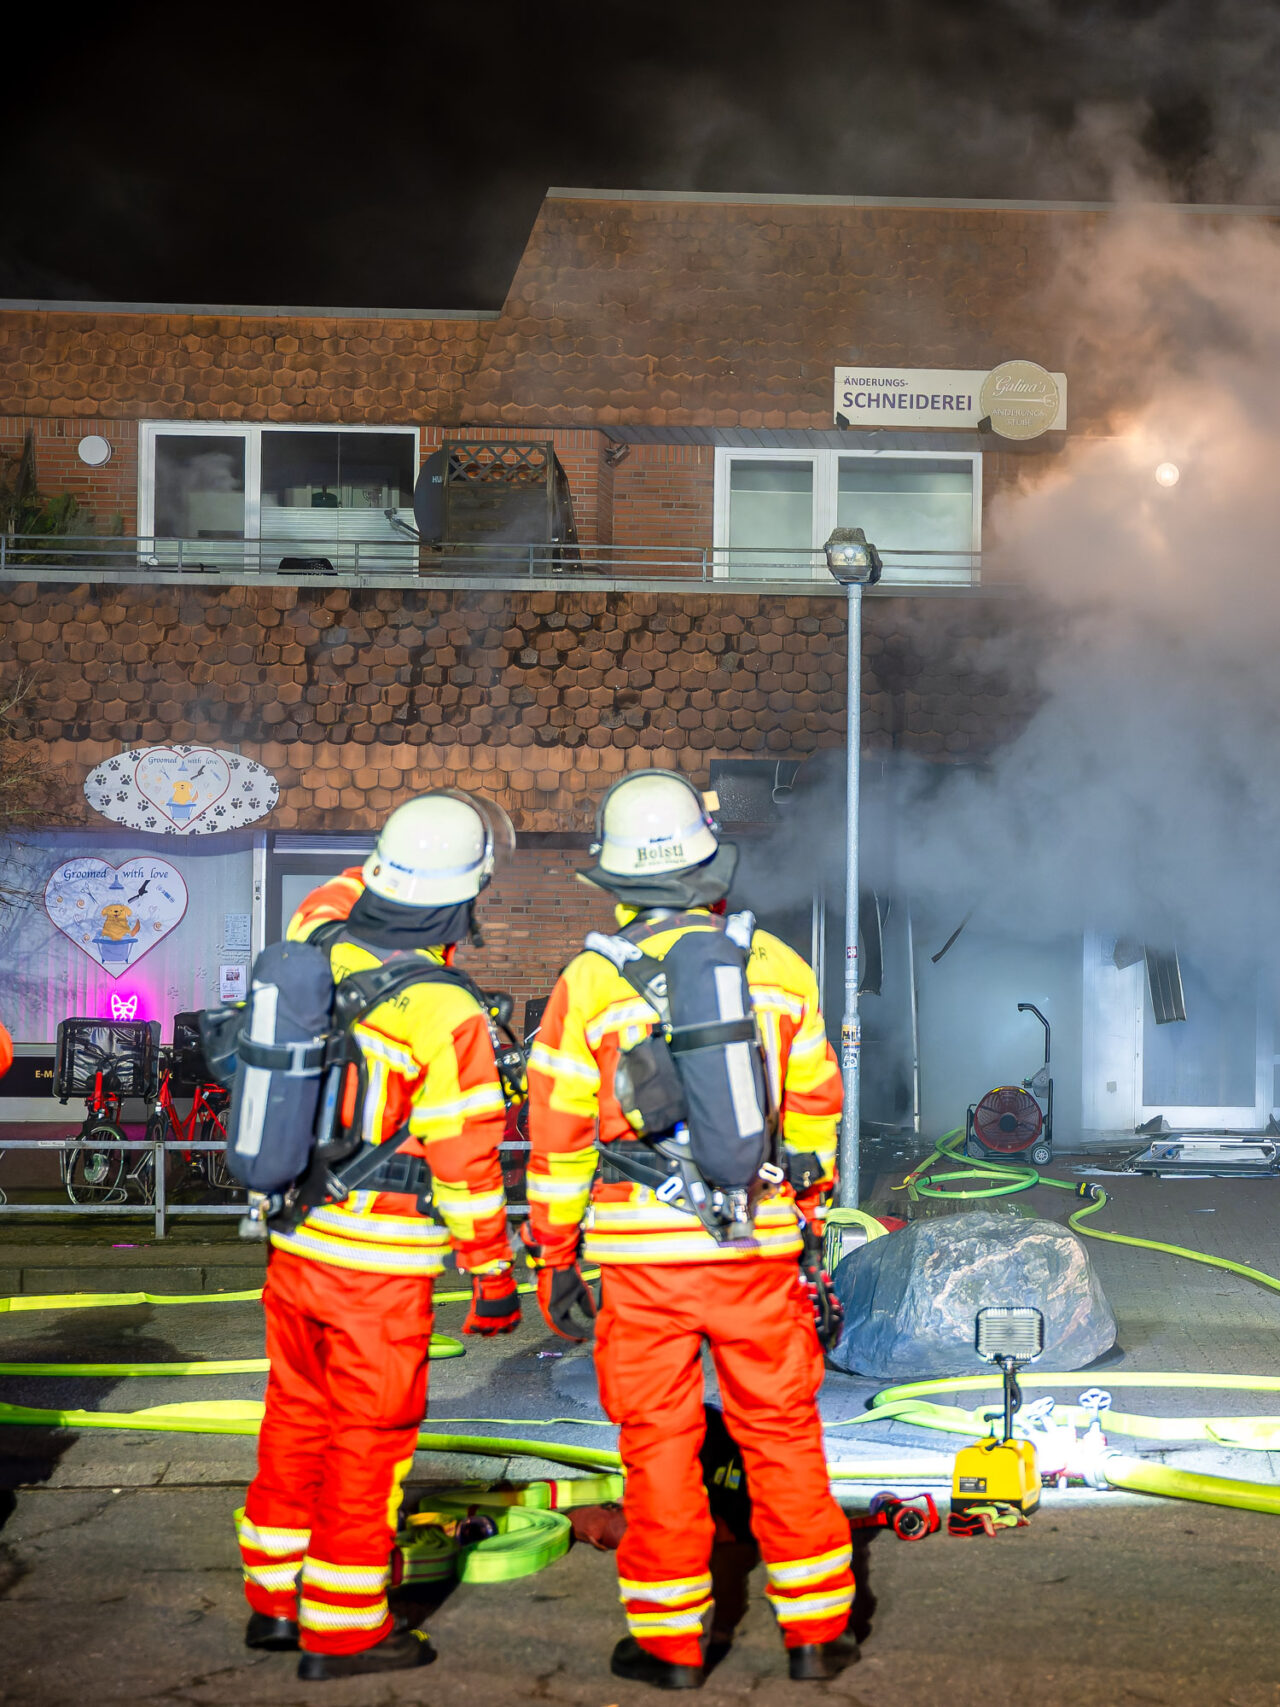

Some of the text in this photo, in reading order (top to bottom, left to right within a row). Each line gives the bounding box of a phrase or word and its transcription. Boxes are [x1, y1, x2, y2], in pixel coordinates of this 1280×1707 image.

[844, 376, 909, 387] ÄNDERUNGS-
[992, 375, 1046, 397] Galina's
[843, 391, 972, 411] SCHNEIDEREI
[148, 755, 219, 765] Groomed with love
[63, 866, 169, 881] Groomed with love
